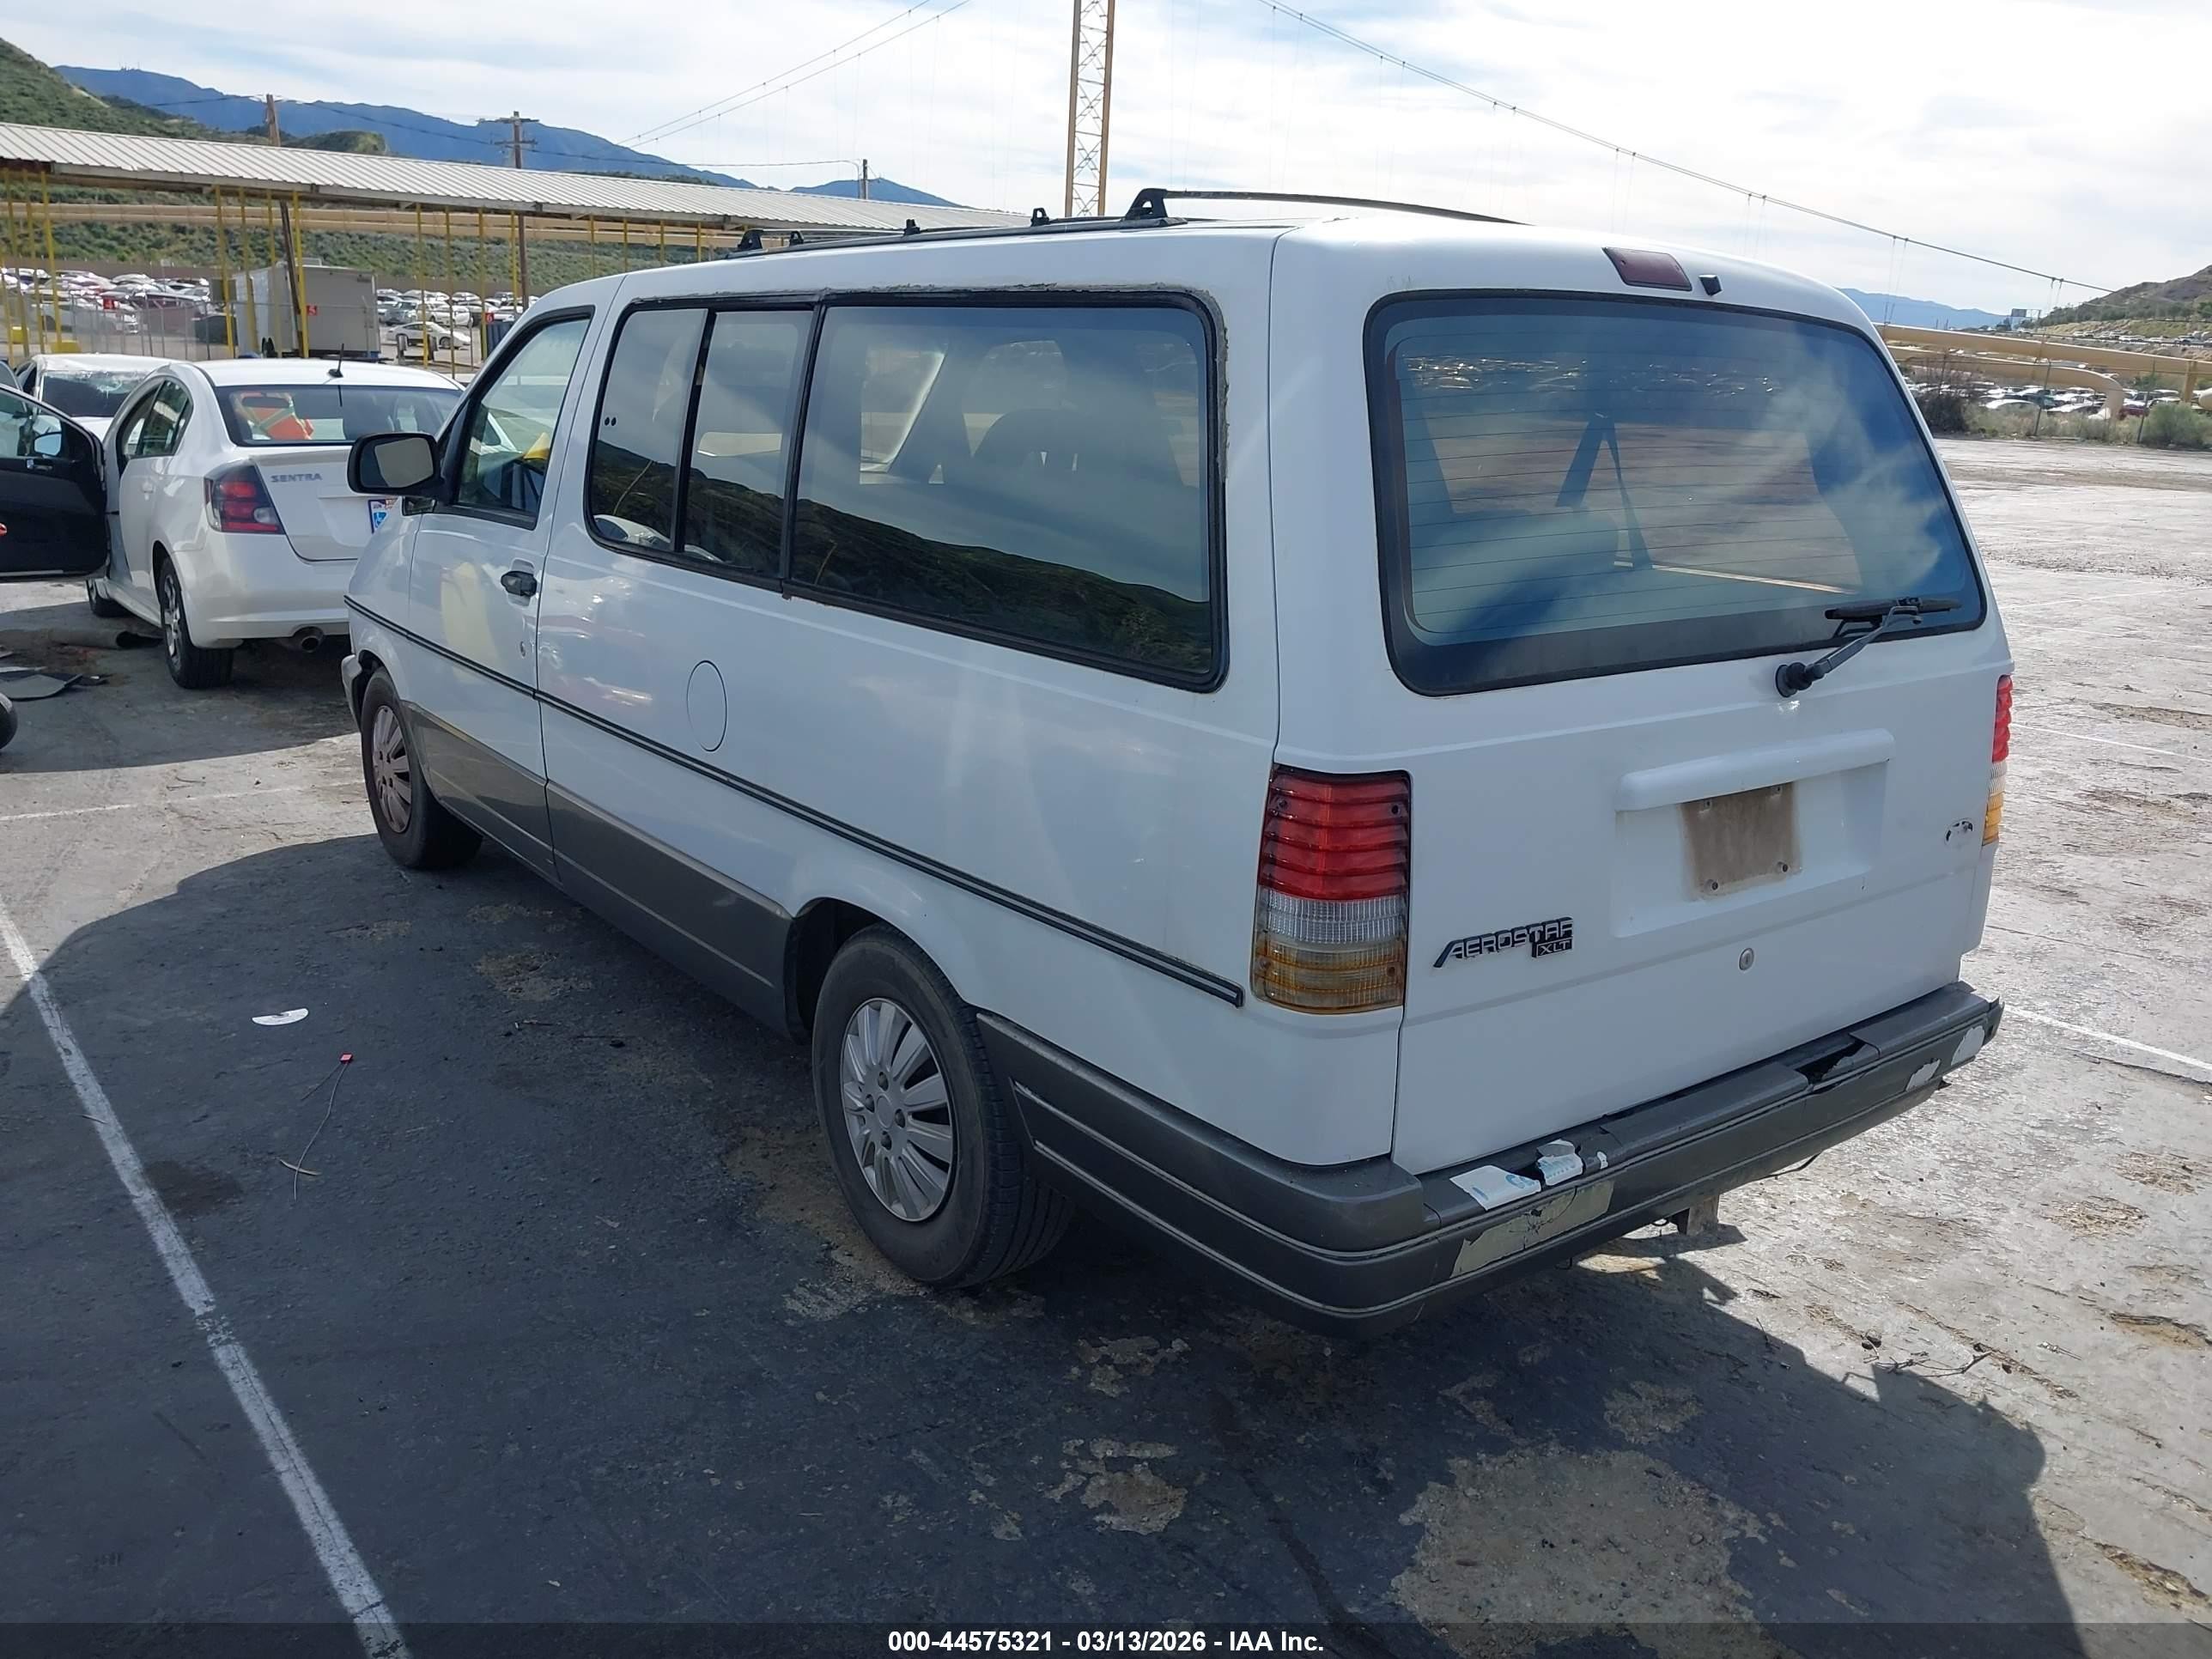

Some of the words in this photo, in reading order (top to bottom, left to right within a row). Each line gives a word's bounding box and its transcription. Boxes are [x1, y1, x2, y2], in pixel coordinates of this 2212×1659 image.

[270, 473, 323, 483] SENTRA
[1433, 916, 1573, 968] AEROSTAR
[1540, 939, 1571, 956] XLT
